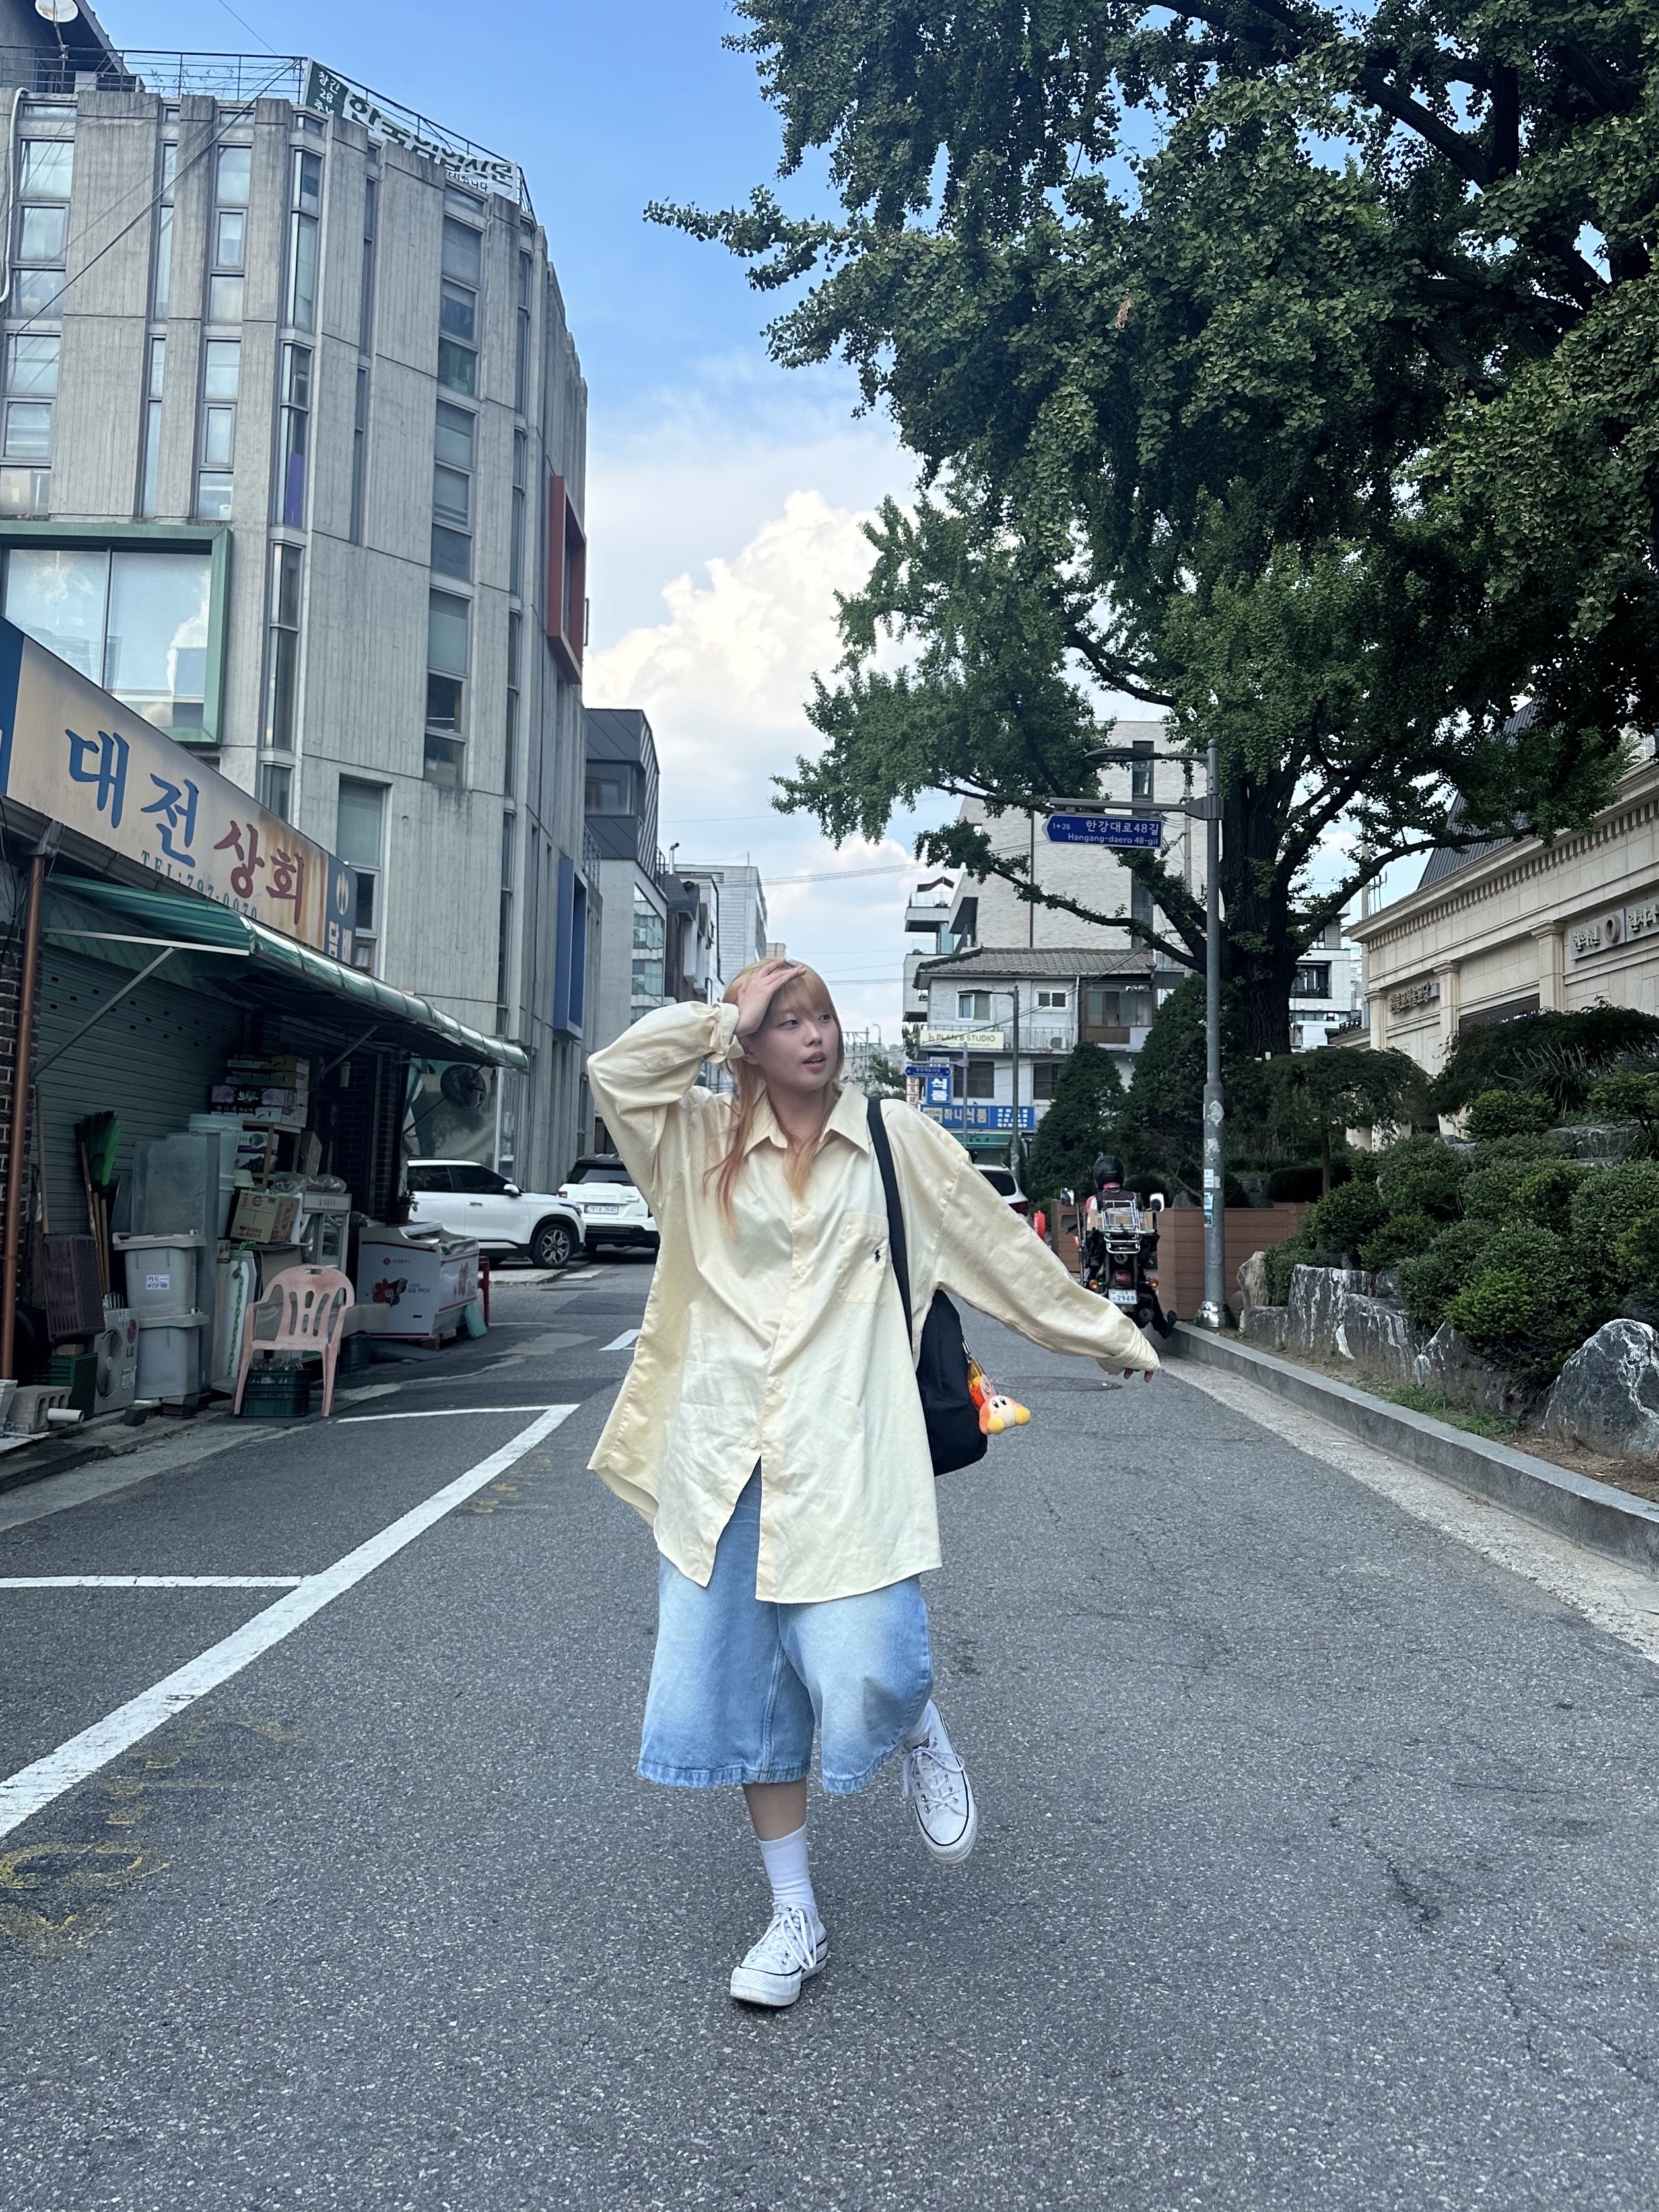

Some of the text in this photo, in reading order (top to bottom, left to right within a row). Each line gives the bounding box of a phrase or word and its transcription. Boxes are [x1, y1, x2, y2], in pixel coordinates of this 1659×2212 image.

[318, 71, 341, 95] 창간
[319, 88, 334, 104] 28
[1085, 820, 1159, 836] 한강대로48길
[1067, 833, 1158, 846] Hangang-daero 48-gil
